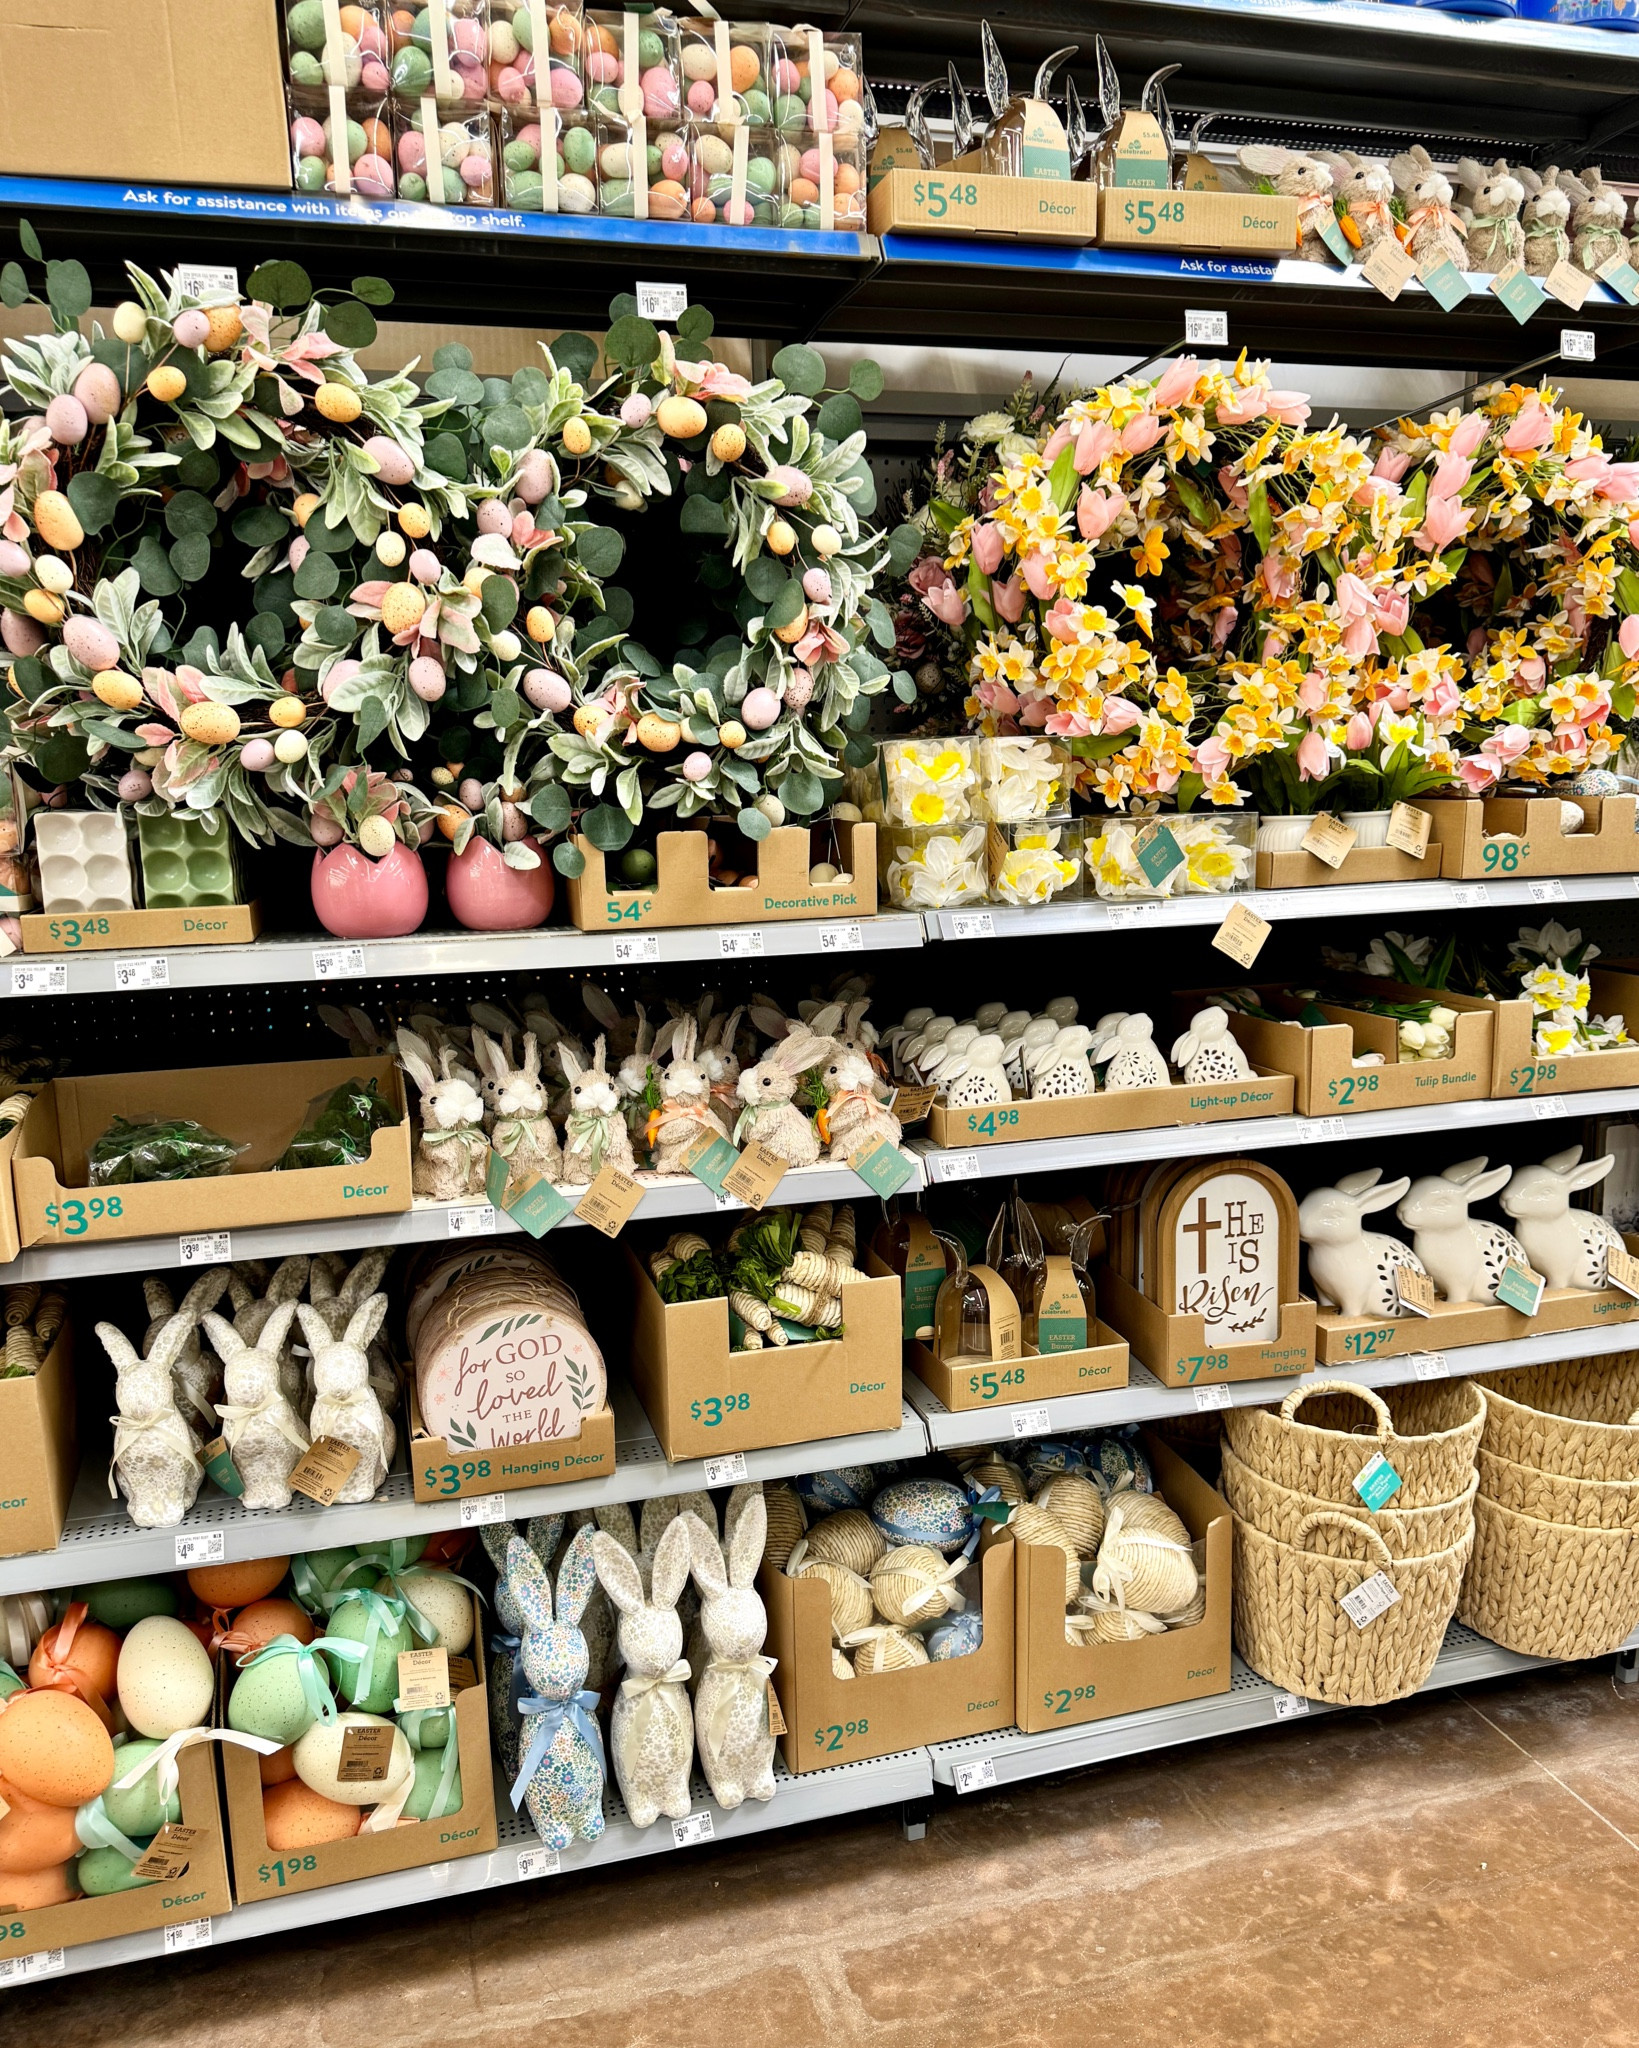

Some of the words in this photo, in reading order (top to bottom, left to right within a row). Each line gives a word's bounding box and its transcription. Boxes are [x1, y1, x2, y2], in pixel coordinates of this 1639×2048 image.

[1033, 167, 1060, 178] EASTER
[1126, 178, 1156, 187] EASTER
[122, 189, 159, 204] Ask
[163, 191, 192, 206] for
[196, 197, 287, 213] assistance
[291, 201, 330, 216] with
[481, 212, 526, 228] shelf.
[1039, 200, 1077, 215] Décor
[1242, 216, 1278, 230] Décor
[1180, 259, 1203, 272] Ask
[1207, 262, 1227, 273] for
[764, 898, 829, 909] Decorative
[832, 893, 857, 906] Pick
[183, 918, 228, 932] Décor
[1415, 1077, 1439, 1087] Tulip
[1442, 1072, 1477, 1084] Bundle
[1189, 1096, 1237, 1109] Light-up
[1240, 1091, 1274, 1103] Décor
[611, 1180, 628, 1193] Décor
[613, 1171, 634, 1188] EASTER
[343, 1184, 389, 1199] Décor
[1593, 1301, 1632, 1315] Light-up
[1049, 1334, 1076, 1342] EASTER
[1051, 1342, 1074, 1351] Bunny
[1261, 1347, 1308, 1361] Hanging
[454, 1347, 492, 1397] for
[495, 1334, 562, 1365] GOD
[1079, 1366, 1112, 1377] Décor
[1274, 1362, 1308, 1374] Décor
[467, 1361, 563, 1420] loved
[849, 1381, 886, 1394] Décor
[502, 1410, 532, 1423] THE
[327, 1445, 344, 1457] Décor
[329, 1438, 351, 1453] EASTER
[501, 1460, 560, 1475] Hanging
[564, 1453, 605, 1467] Décor
[410, 1651, 433, 1659] EASTER
[1187, 1667, 1217, 1680] Décor
[967, 1698, 1000, 1713] Décor
[174, 1826, 197, 1835] EASTER
[440, 1826, 481, 1844] Décor
[171, 1834, 190, 1842] Décor
[162, 1892, 207, 1910] Décor
